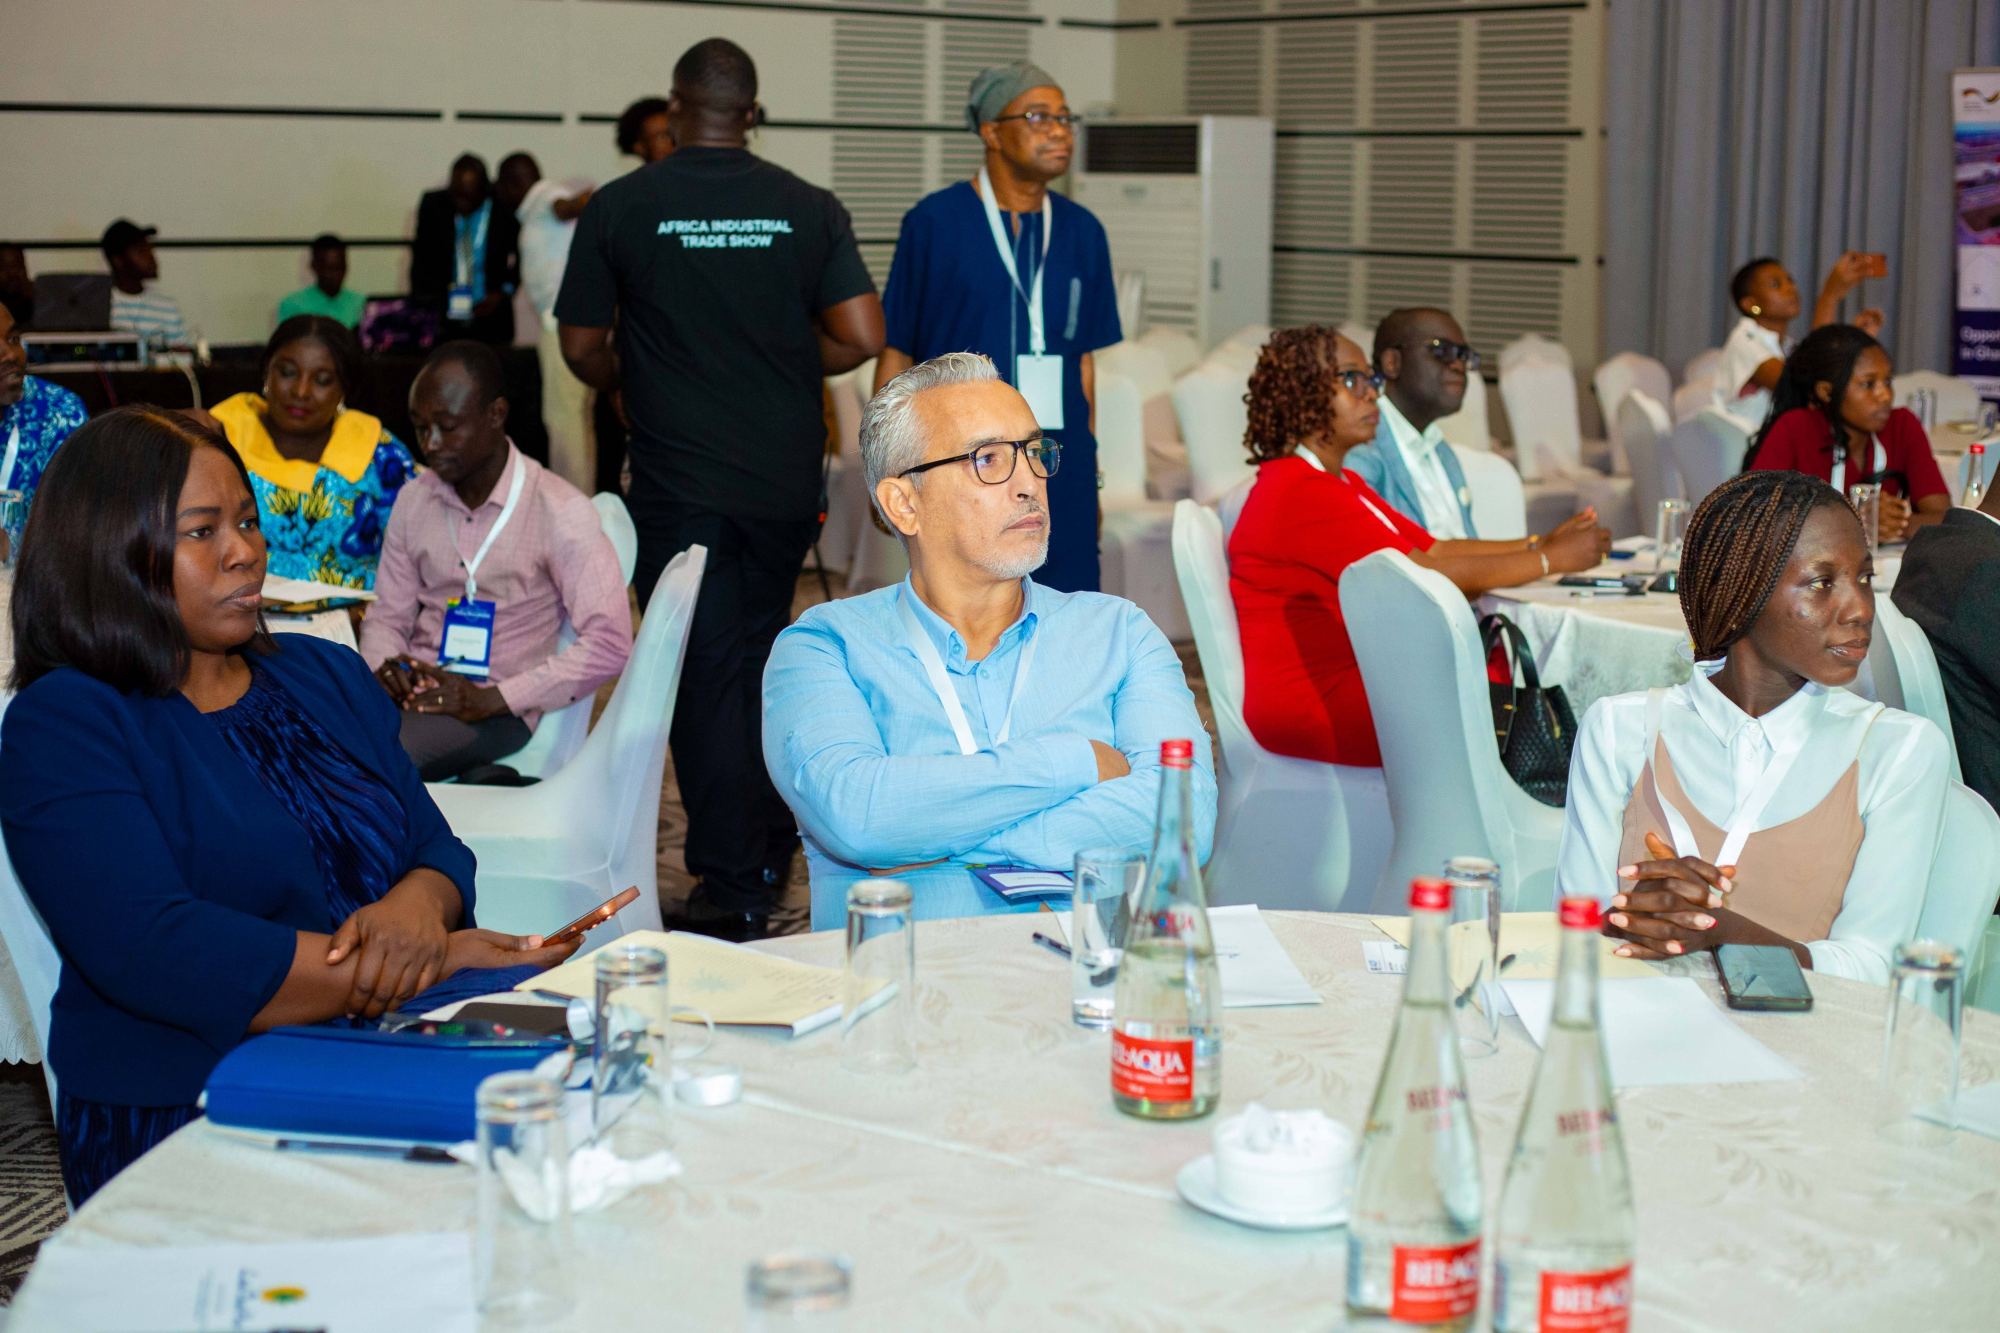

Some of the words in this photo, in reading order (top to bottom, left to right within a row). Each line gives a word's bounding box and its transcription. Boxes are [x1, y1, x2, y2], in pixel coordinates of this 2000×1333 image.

[657, 220, 710, 235] AFRICA
[711, 219, 794, 233] INDUSTRIAL
[680, 235, 727, 248] TRADE
[728, 234, 773, 248] SHOW
